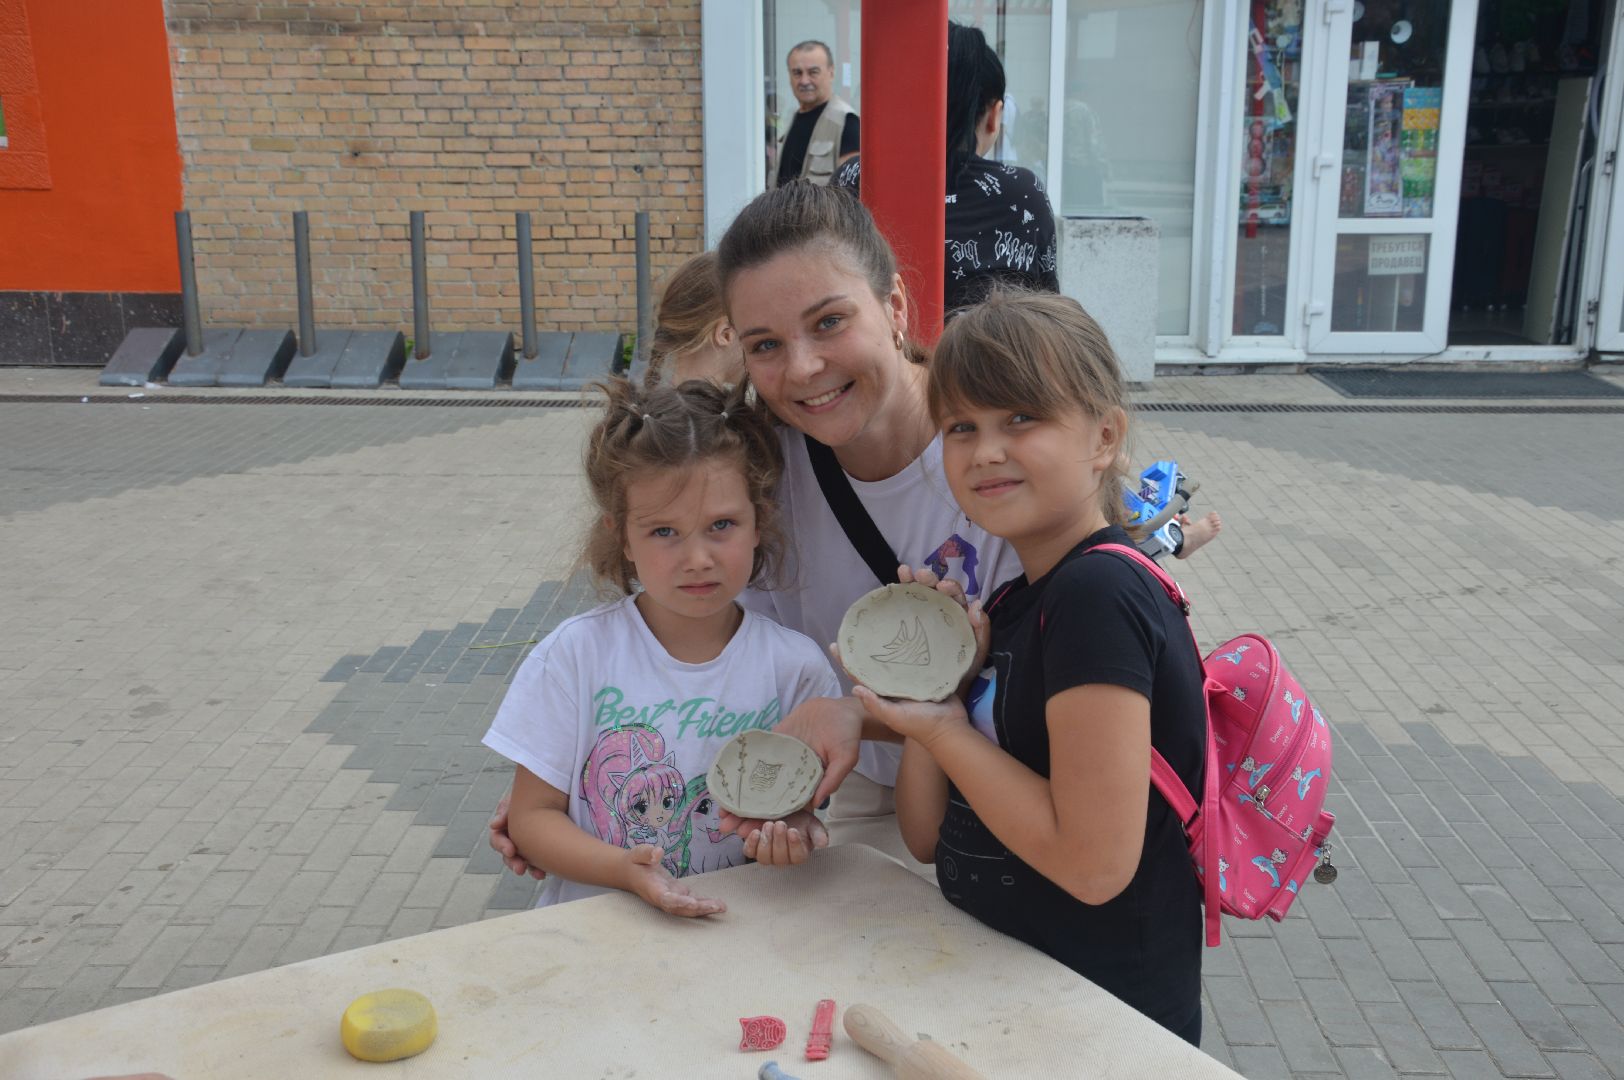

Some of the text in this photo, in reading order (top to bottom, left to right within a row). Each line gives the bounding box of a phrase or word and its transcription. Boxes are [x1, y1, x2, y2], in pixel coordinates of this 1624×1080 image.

[1372, 240, 1424, 253] ТРЕБУЕТСЯ
[1371, 256, 1422, 269] ПРОДАВЕЦ
[593, 686, 677, 729] Best
